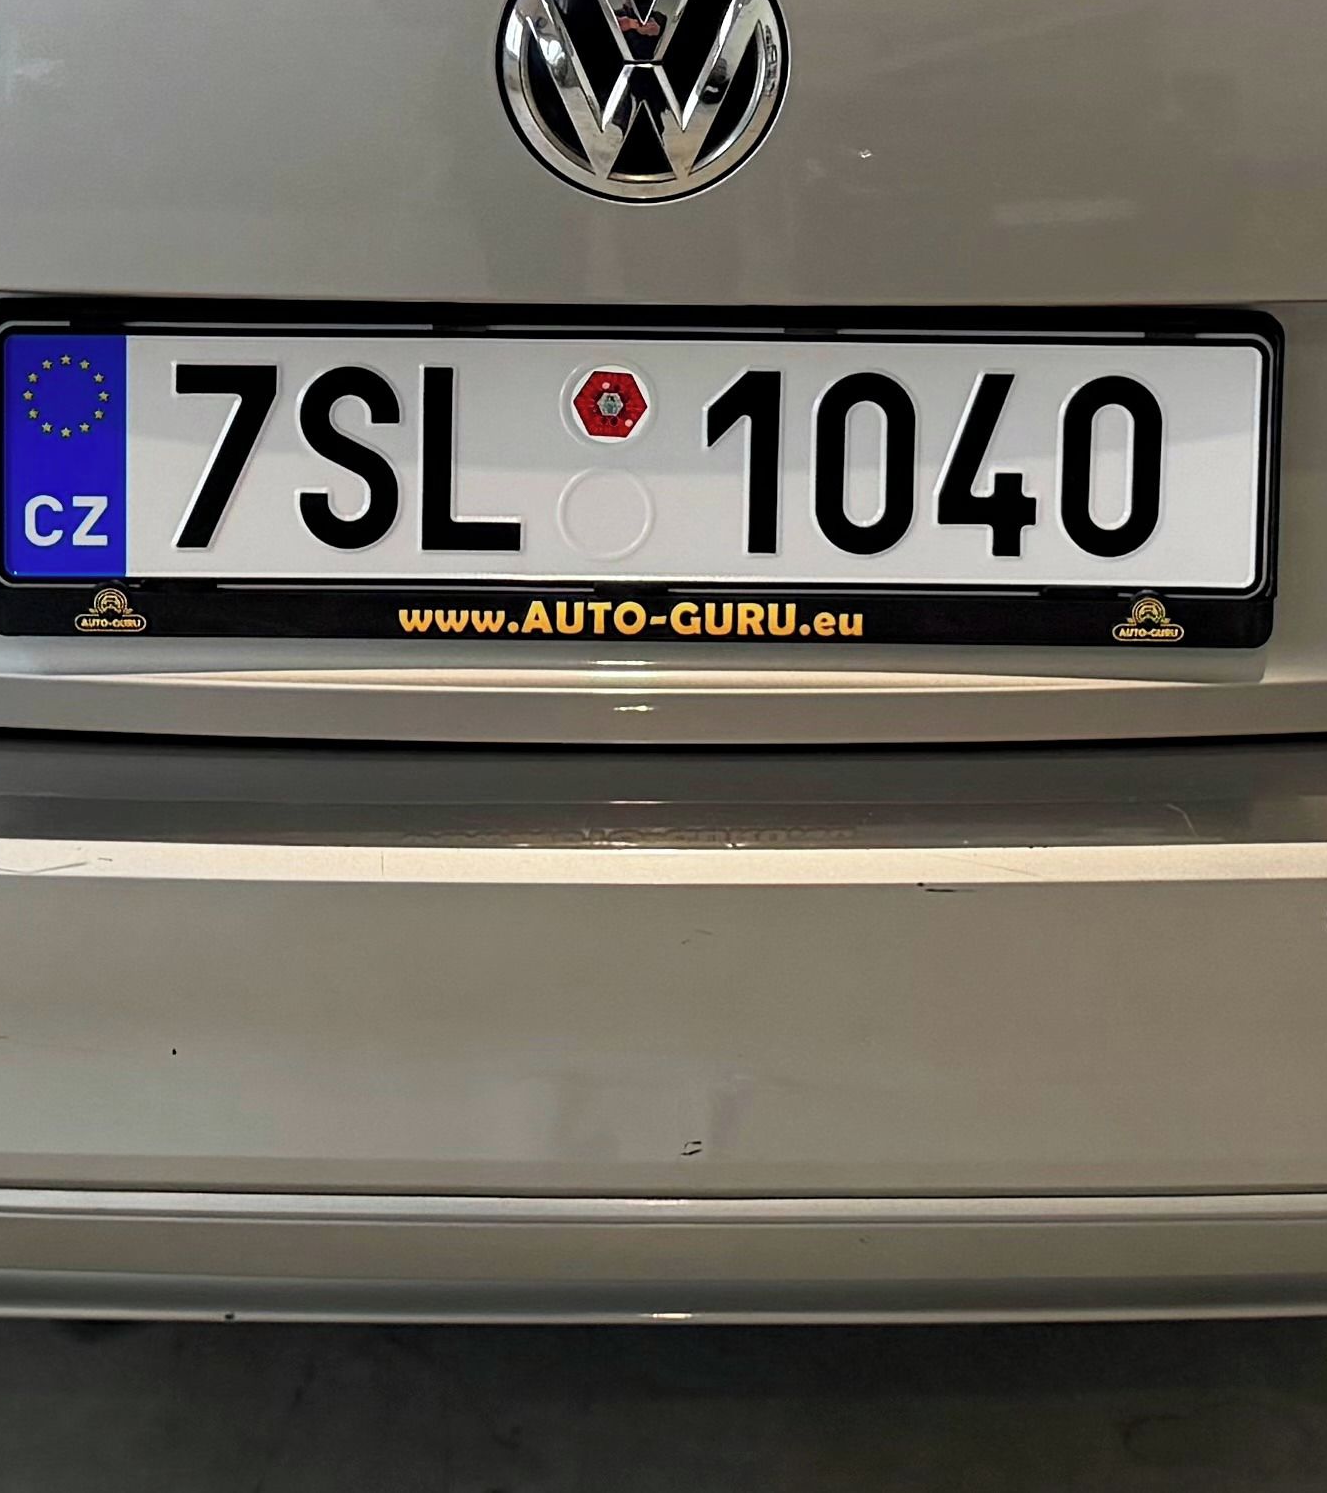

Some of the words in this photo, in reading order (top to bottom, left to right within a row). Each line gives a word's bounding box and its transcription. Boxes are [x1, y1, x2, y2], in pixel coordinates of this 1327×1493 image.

[174, 363, 523, 553] 7SL
[705, 369, 1165, 558] 1040
[23, 495, 109, 547] CZ
[398, 600, 864, 638] www.AUTO-GURU.eu
